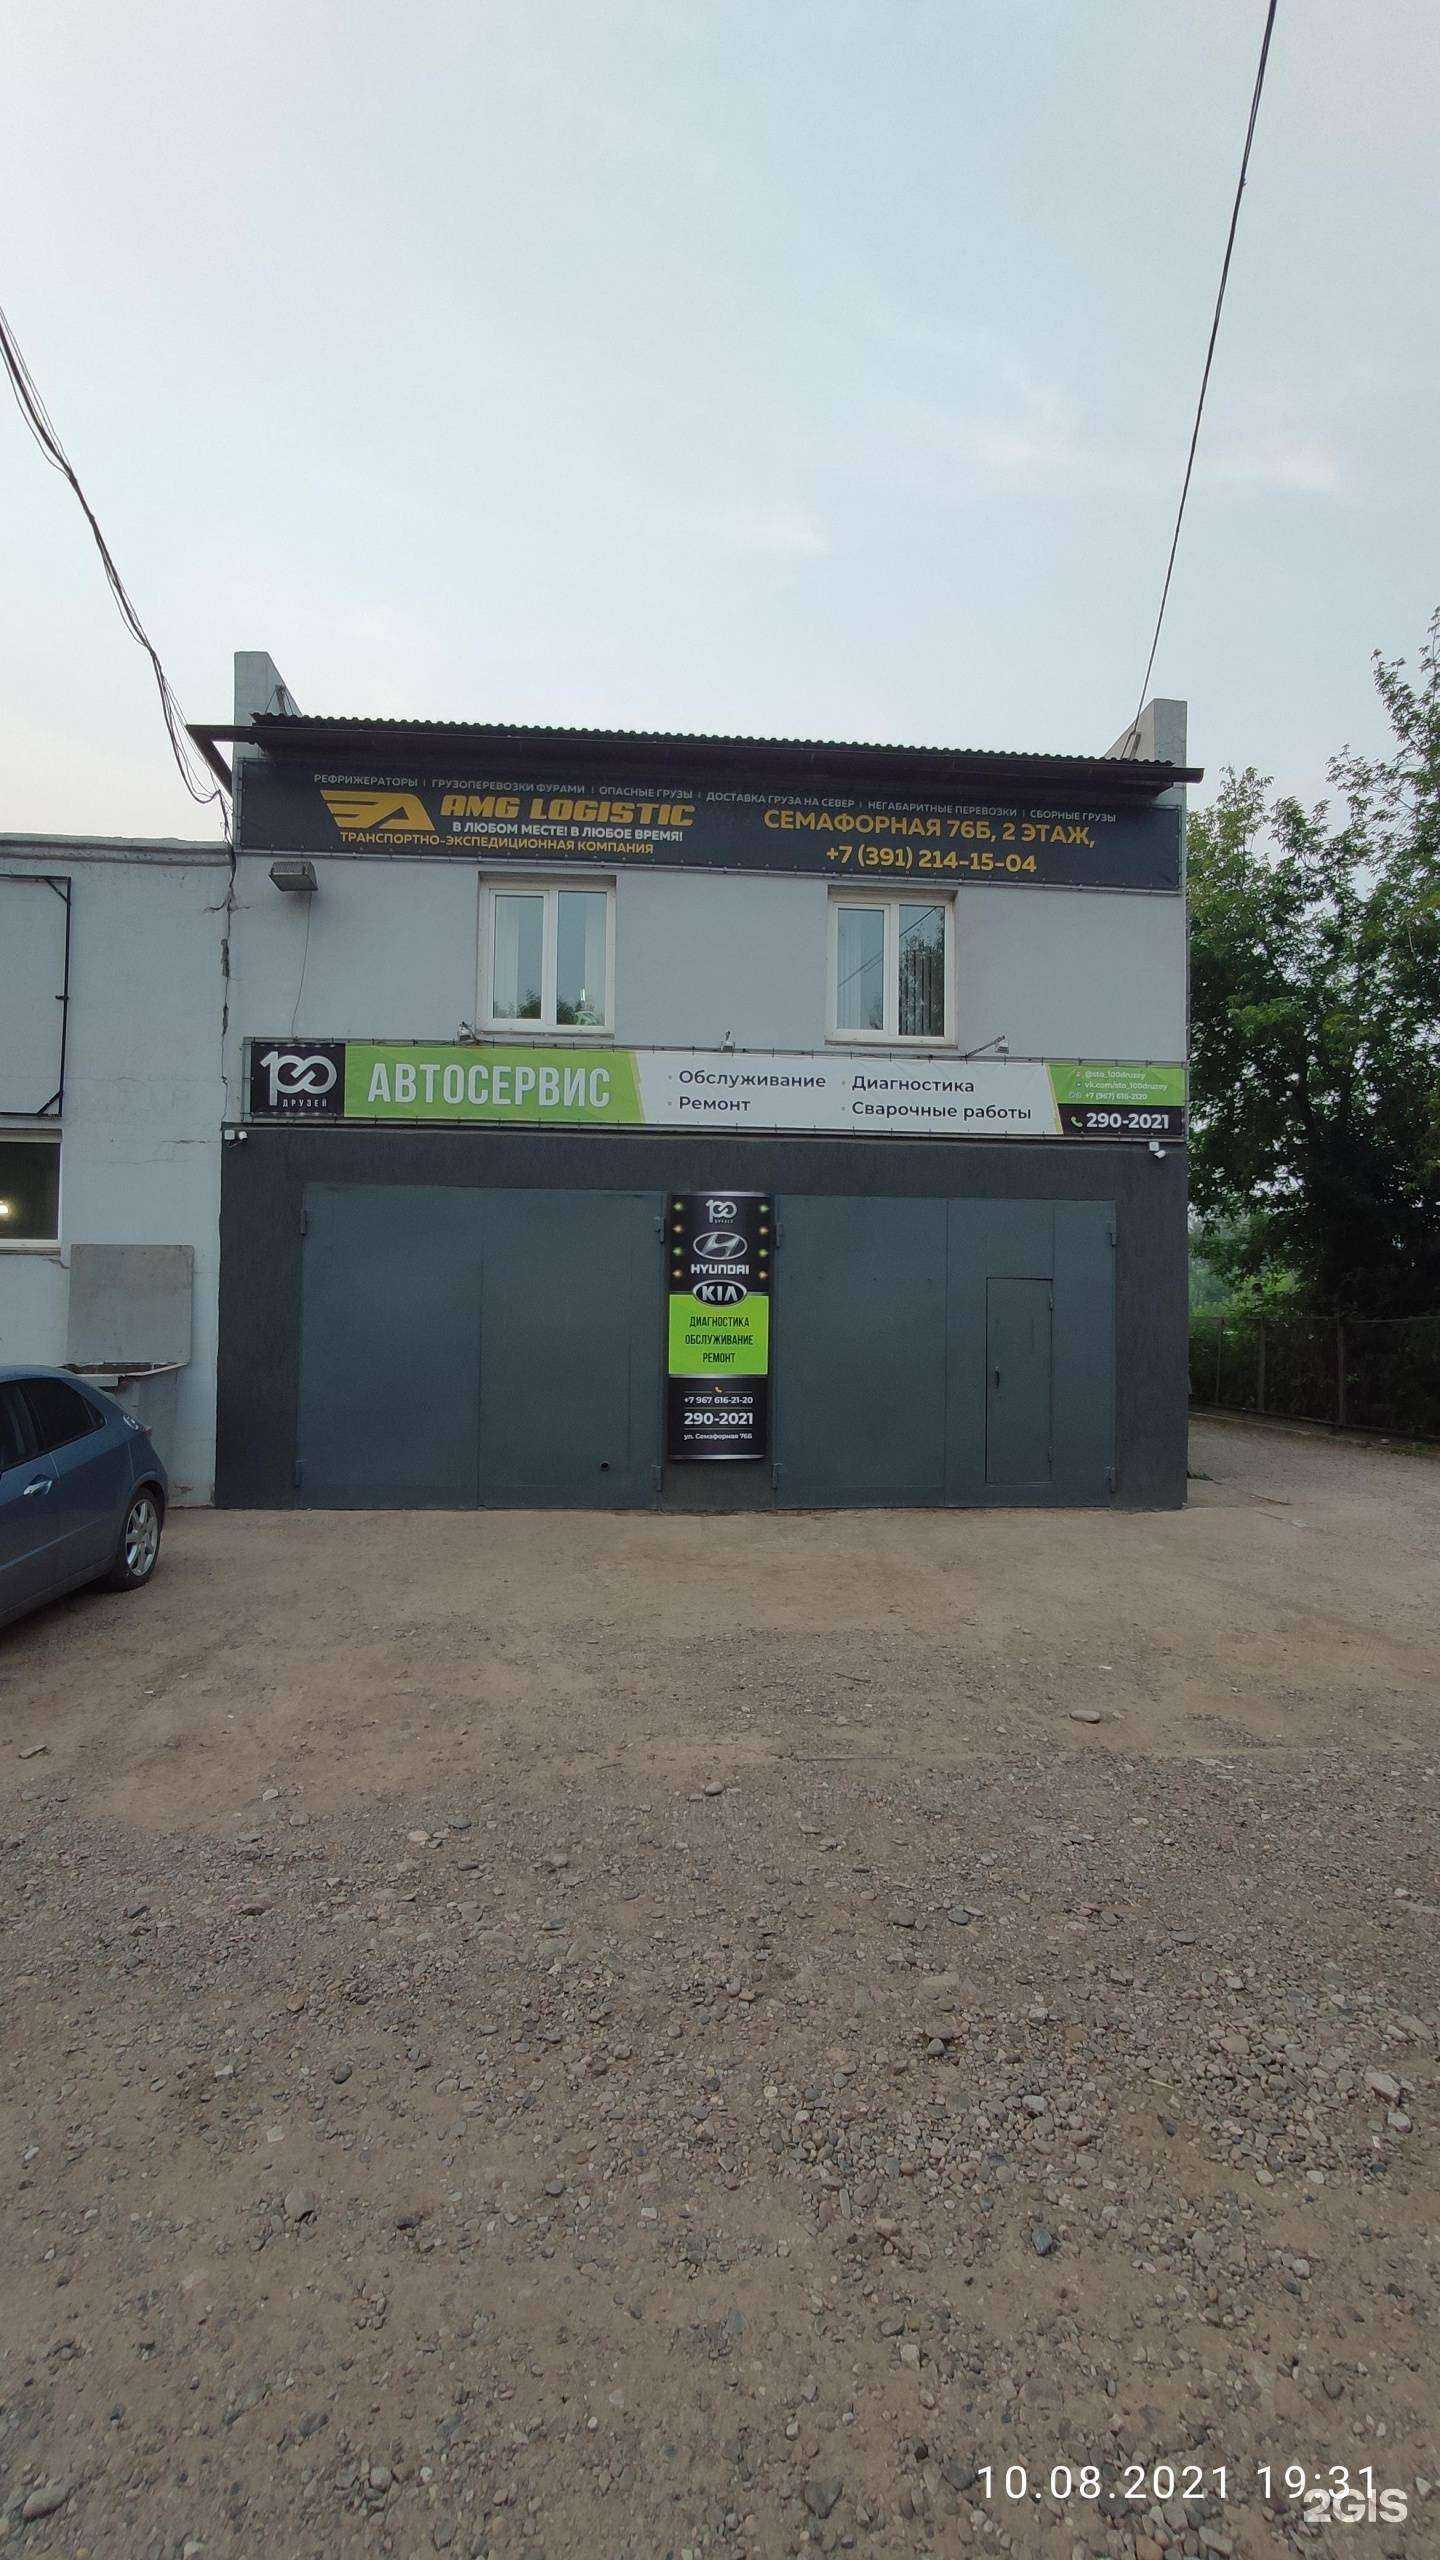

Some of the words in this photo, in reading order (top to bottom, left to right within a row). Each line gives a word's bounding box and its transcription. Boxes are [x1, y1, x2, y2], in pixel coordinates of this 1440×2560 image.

[314, 774, 418, 787] РЕФРИЖЕРАТОРЫ
[432, 778, 533, 792] ГРУЗОПЕРЕВОЗКИ
[536, 783, 585, 794] ФУРАМИ
[599, 786, 654, 797] ОПАСНЫЕ
[657, 788, 692, 799] ГРУЗЫ
[706, 791, 765, 803] ДОСТАВКА
[768, 795, 801, 805] ГРУЗА
[804, 797, 819, 806] НА
[821, 798, 854, 808] СЕВЕР
[868, 801, 952, 813] НЕГАБАРИТНЫЕ
[955, 805, 1017, 816] ПЕРЕВОЗКИ
[1030, 809, 1079, 820] СБОРНЫЕ
[1082, 812, 1116, 822] ГРУЗЫ
[440, 795, 520, 819] AMG
[529, 798, 695, 826] LOGISTIC
[452, 822, 461, 832] В
[464, 822, 518, 834] ЛЮБОМ
[521, 824, 568, 836] МЕСТЕ!
[571, 826, 579, 837] В
[581, 827, 632, 839] ЛЮБОЕ
[635, 829, 683, 842] ВРЕМЯ!
[763, 809, 941, 837] СЕМАФОРНАЯ
[947, 820, 996, 842] 76Б,
[1002, 822, 1015, 841] 2
[1021, 823, 1096, 848] ЭТАЖ,
[340, 831, 574, 850] ТРАНСПОРТНО-ЭКСПЕДИЦИОННАЯ
[578, 840, 654, 854] КОМПАНИЯ
[826, 845, 853, 864] +7
[858, 843, 913, 869] (391)
[918, 850, 1037, 873] 214-15-04
[367, 1063, 611, 1107] АВТОСЕРВИС
[679, 1070, 826, 1088] Обслуживание
[852, 1075, 974, 1092] Диагностика
[282, 1098, 327, 1108] ДРУЗЕЙ
[679, 1096, 751, 1111] Ремонт
[852, 1101, 957, 1118] Сварочные
[963, 1105, 1031, 1121] работы
[1086, 1112, 1169, 1129] 290-2021
[690, 1264, 750, 1275] HYUNDAI
[702, 1285, 738, 1301] KIA
[689, 1316, 749, 1328] ДИАГНОСТИКА
[685, 1334, 753, 1345] ОБСЛУЖИВАНИЕ
[702, 1352, 735, 1363] РЕМОНТ
[684, 1412, 753, 1425] 290-2021
